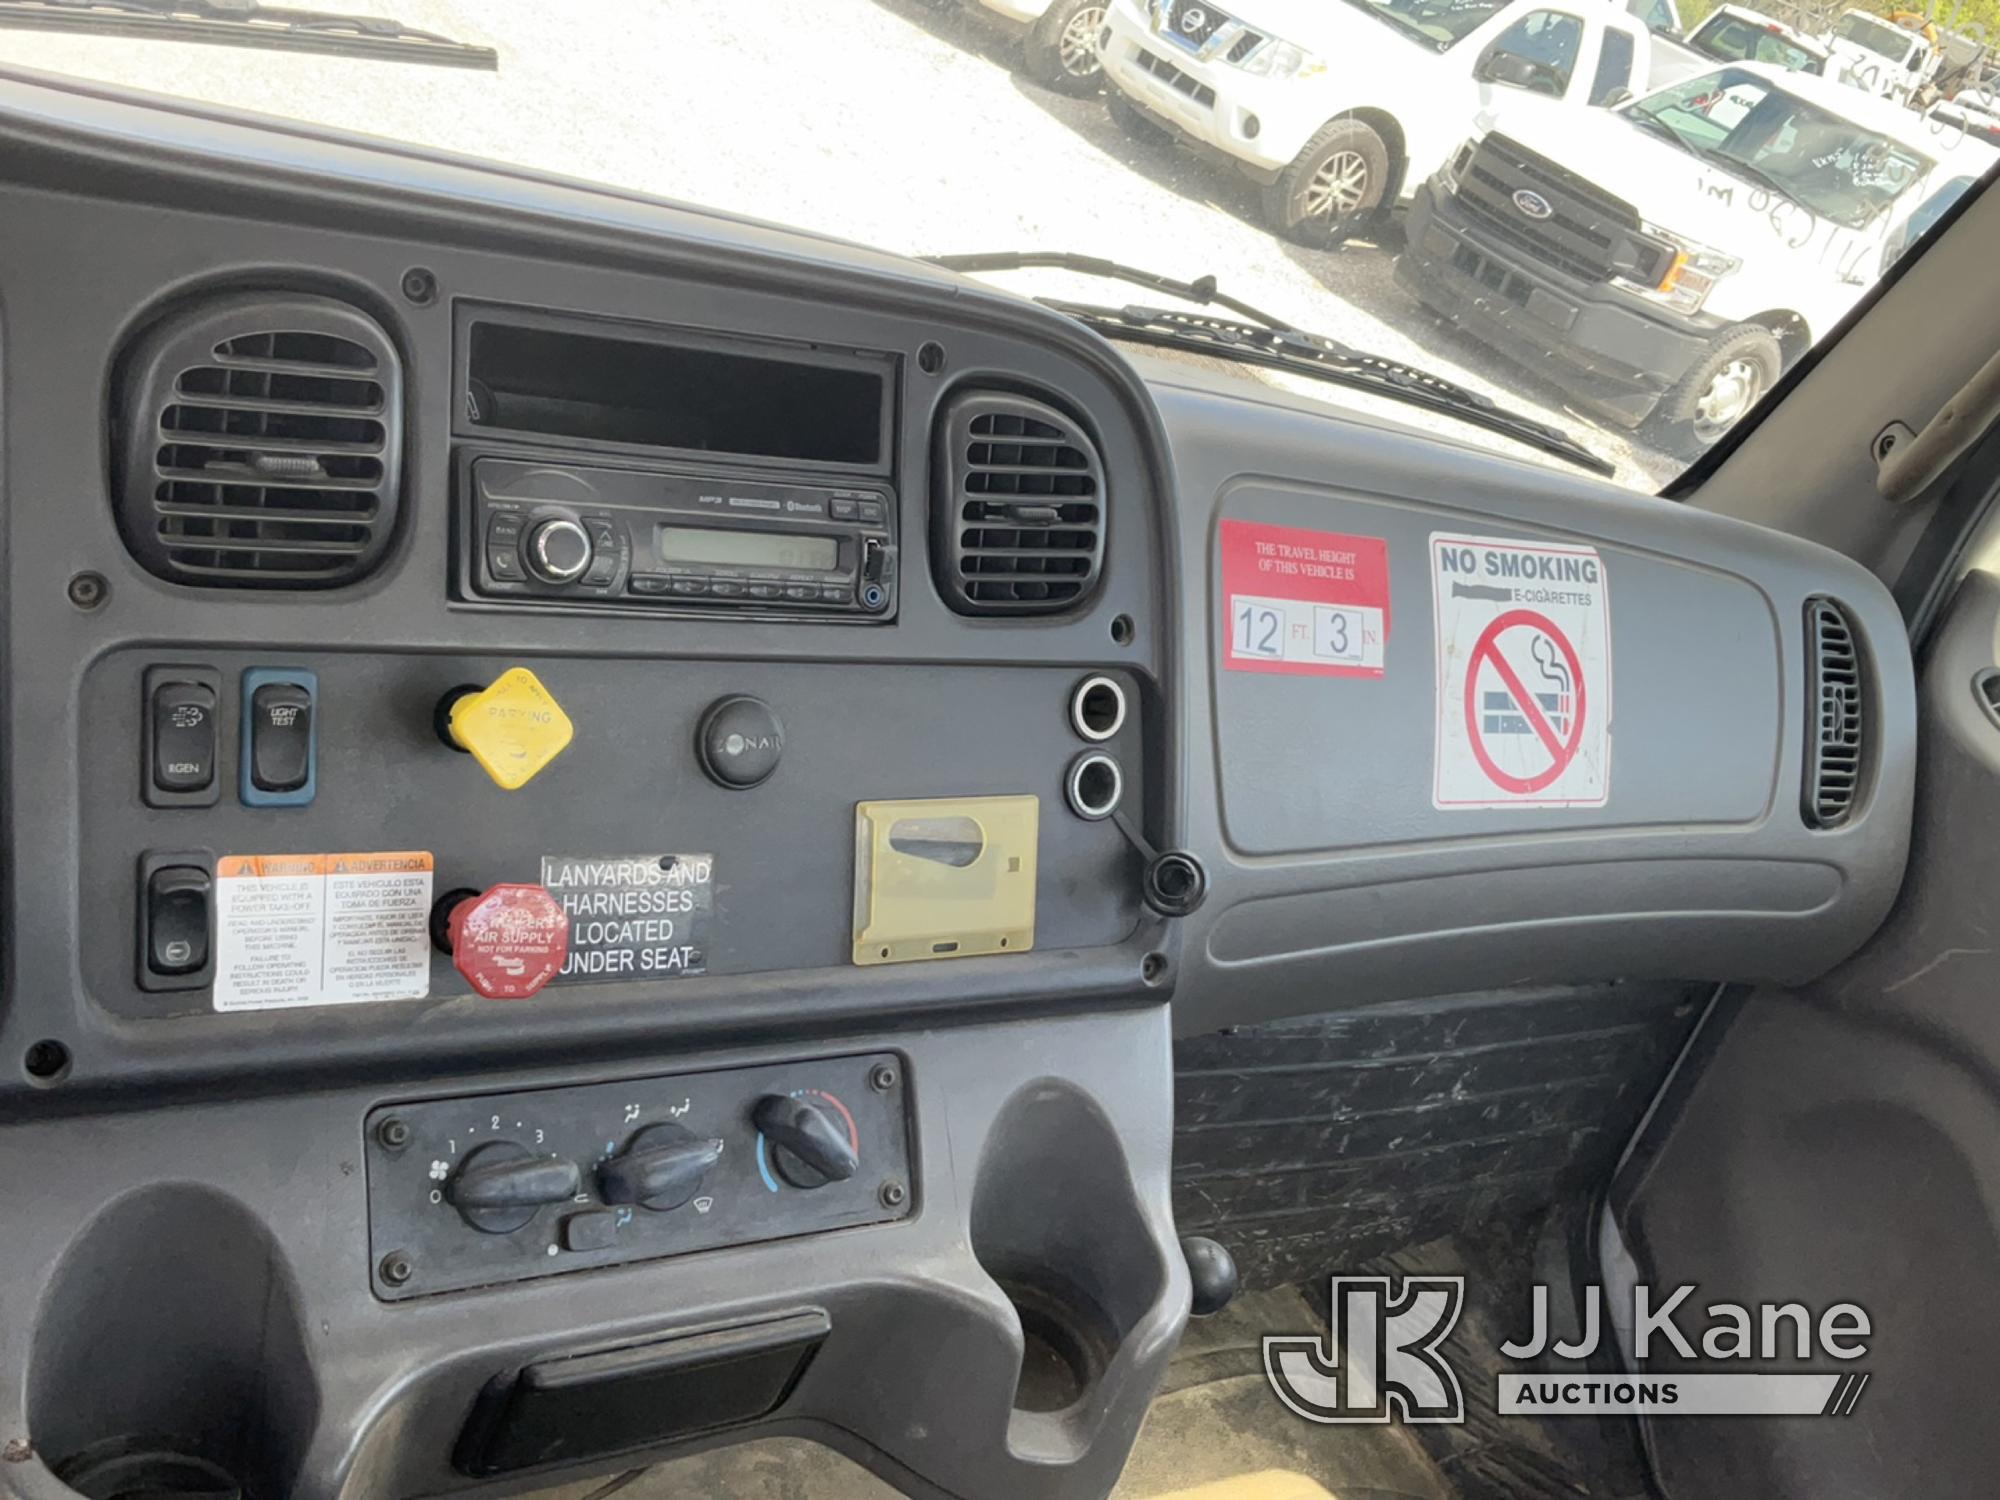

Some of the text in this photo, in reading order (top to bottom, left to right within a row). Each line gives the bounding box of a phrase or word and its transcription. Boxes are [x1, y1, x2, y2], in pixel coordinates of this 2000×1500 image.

[1255, 542, 1357, 565] THE TRAVEL HEIGHT
[1258, 558, 1355, 580] OF THIS VEHICLE IS
[1441, 547, 1598, 584] NO SMOKING
[1514, 588, 1592, 607] E-CIGARETTES
[1239, 606, 1278, 655] 12
[1329, 612, 1349, 654] 3
[270, 708, 298, 717] LIGHT
[271, 717, 295, 727] TEST
[352, 859, 425, 872] ADVERTENCIA
[547, 862, 711, 887] LANYARDS AND
[562, 890, 694, 916] HARNESSES
[474, 930, 555, 945] AIR SUPPLY
[574, 919, 673, 945] LOCATED
[639, 946, 695, 971] SEAT
[491, 1115, 500, 1130] 2
[535, 1129, 544, 1143] 3
[448, 1139, 456, 1154] 1
